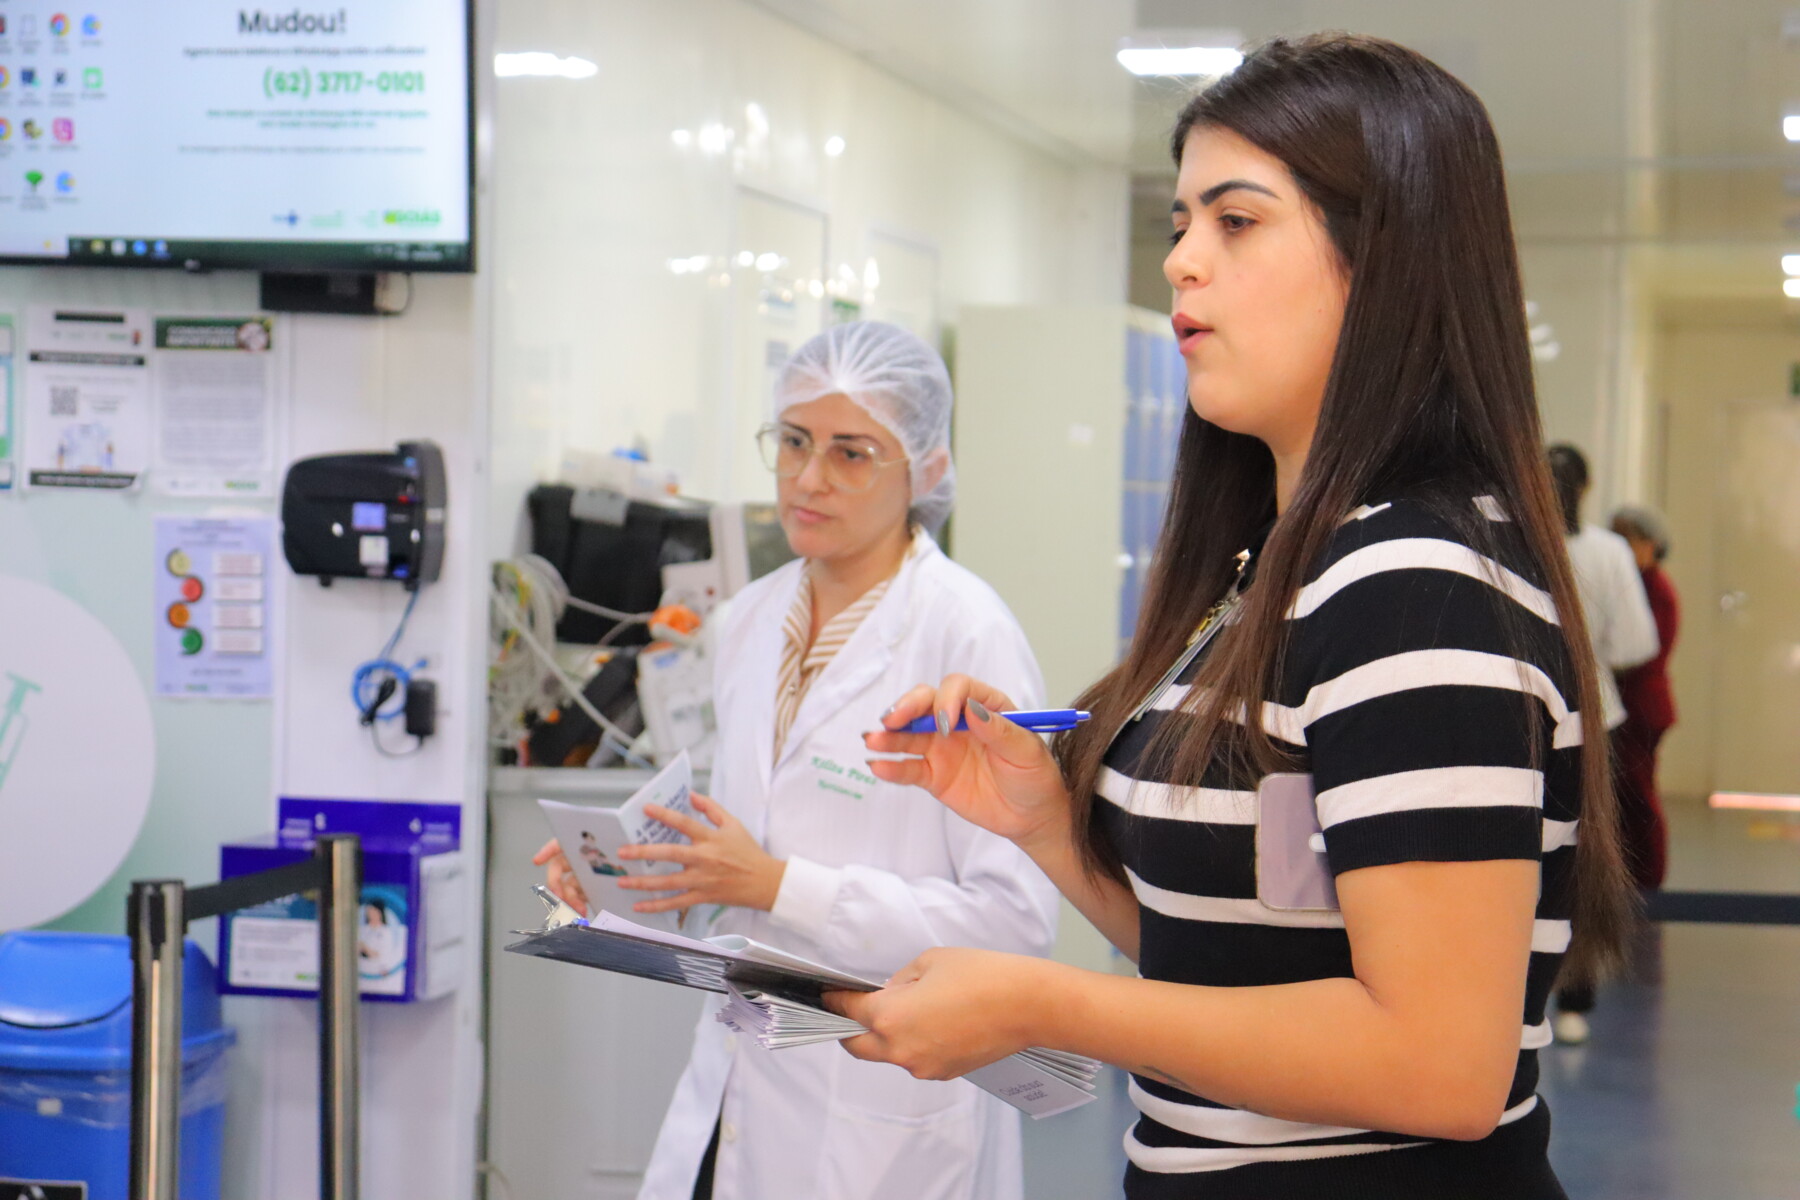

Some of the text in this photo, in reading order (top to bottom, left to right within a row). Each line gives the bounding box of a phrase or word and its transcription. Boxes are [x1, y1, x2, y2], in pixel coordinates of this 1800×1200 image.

[238, 10, 346, 33] Mudou!
[263, 67, 425, 99] (62) 3717-0101
